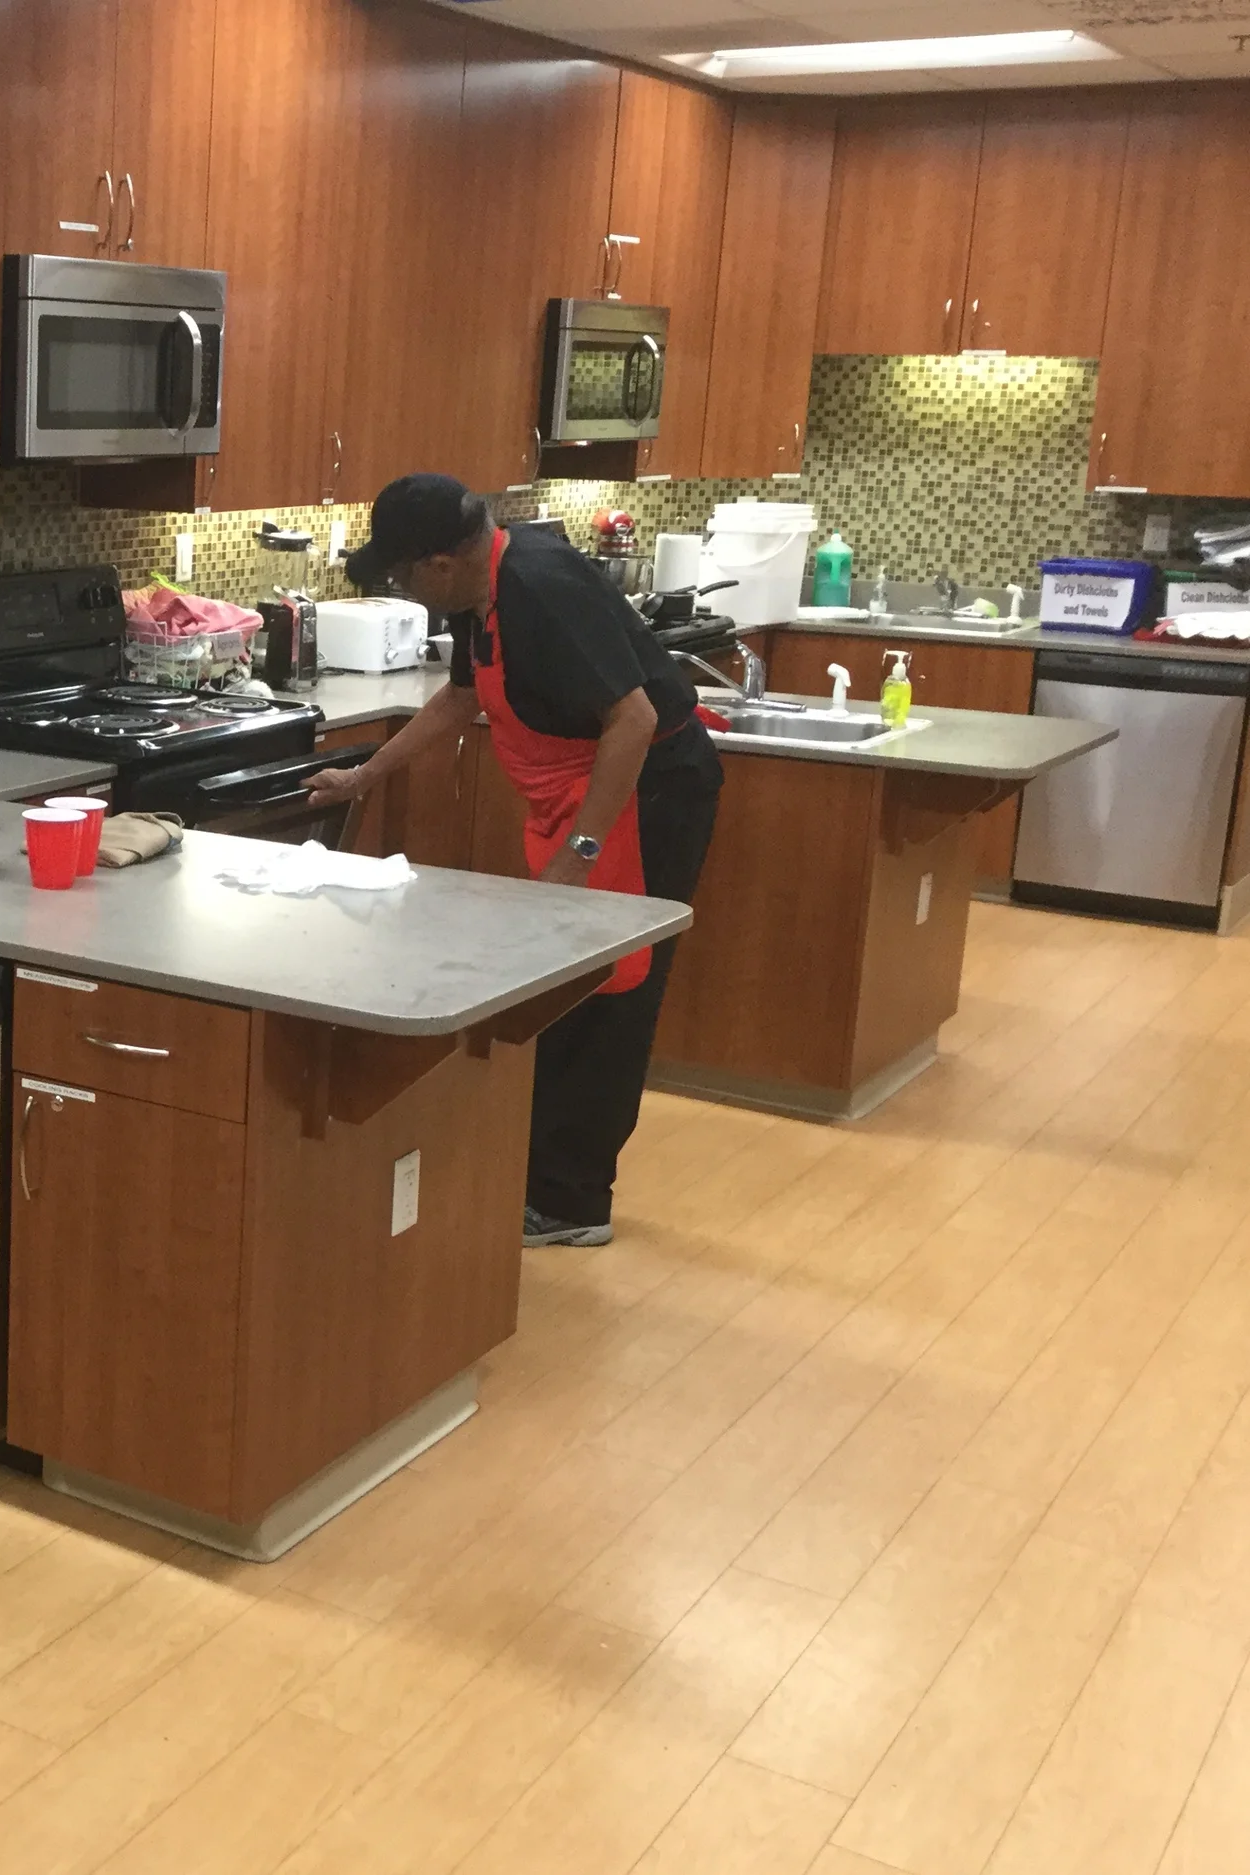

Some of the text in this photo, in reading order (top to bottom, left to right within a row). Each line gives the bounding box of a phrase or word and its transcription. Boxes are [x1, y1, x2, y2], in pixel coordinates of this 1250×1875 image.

[1054, 583, 1118, 598] Dirty Dishcloths
[1181, 591, 1205, 602] Clean
[1064, 604, 1108, 617] and Towels
